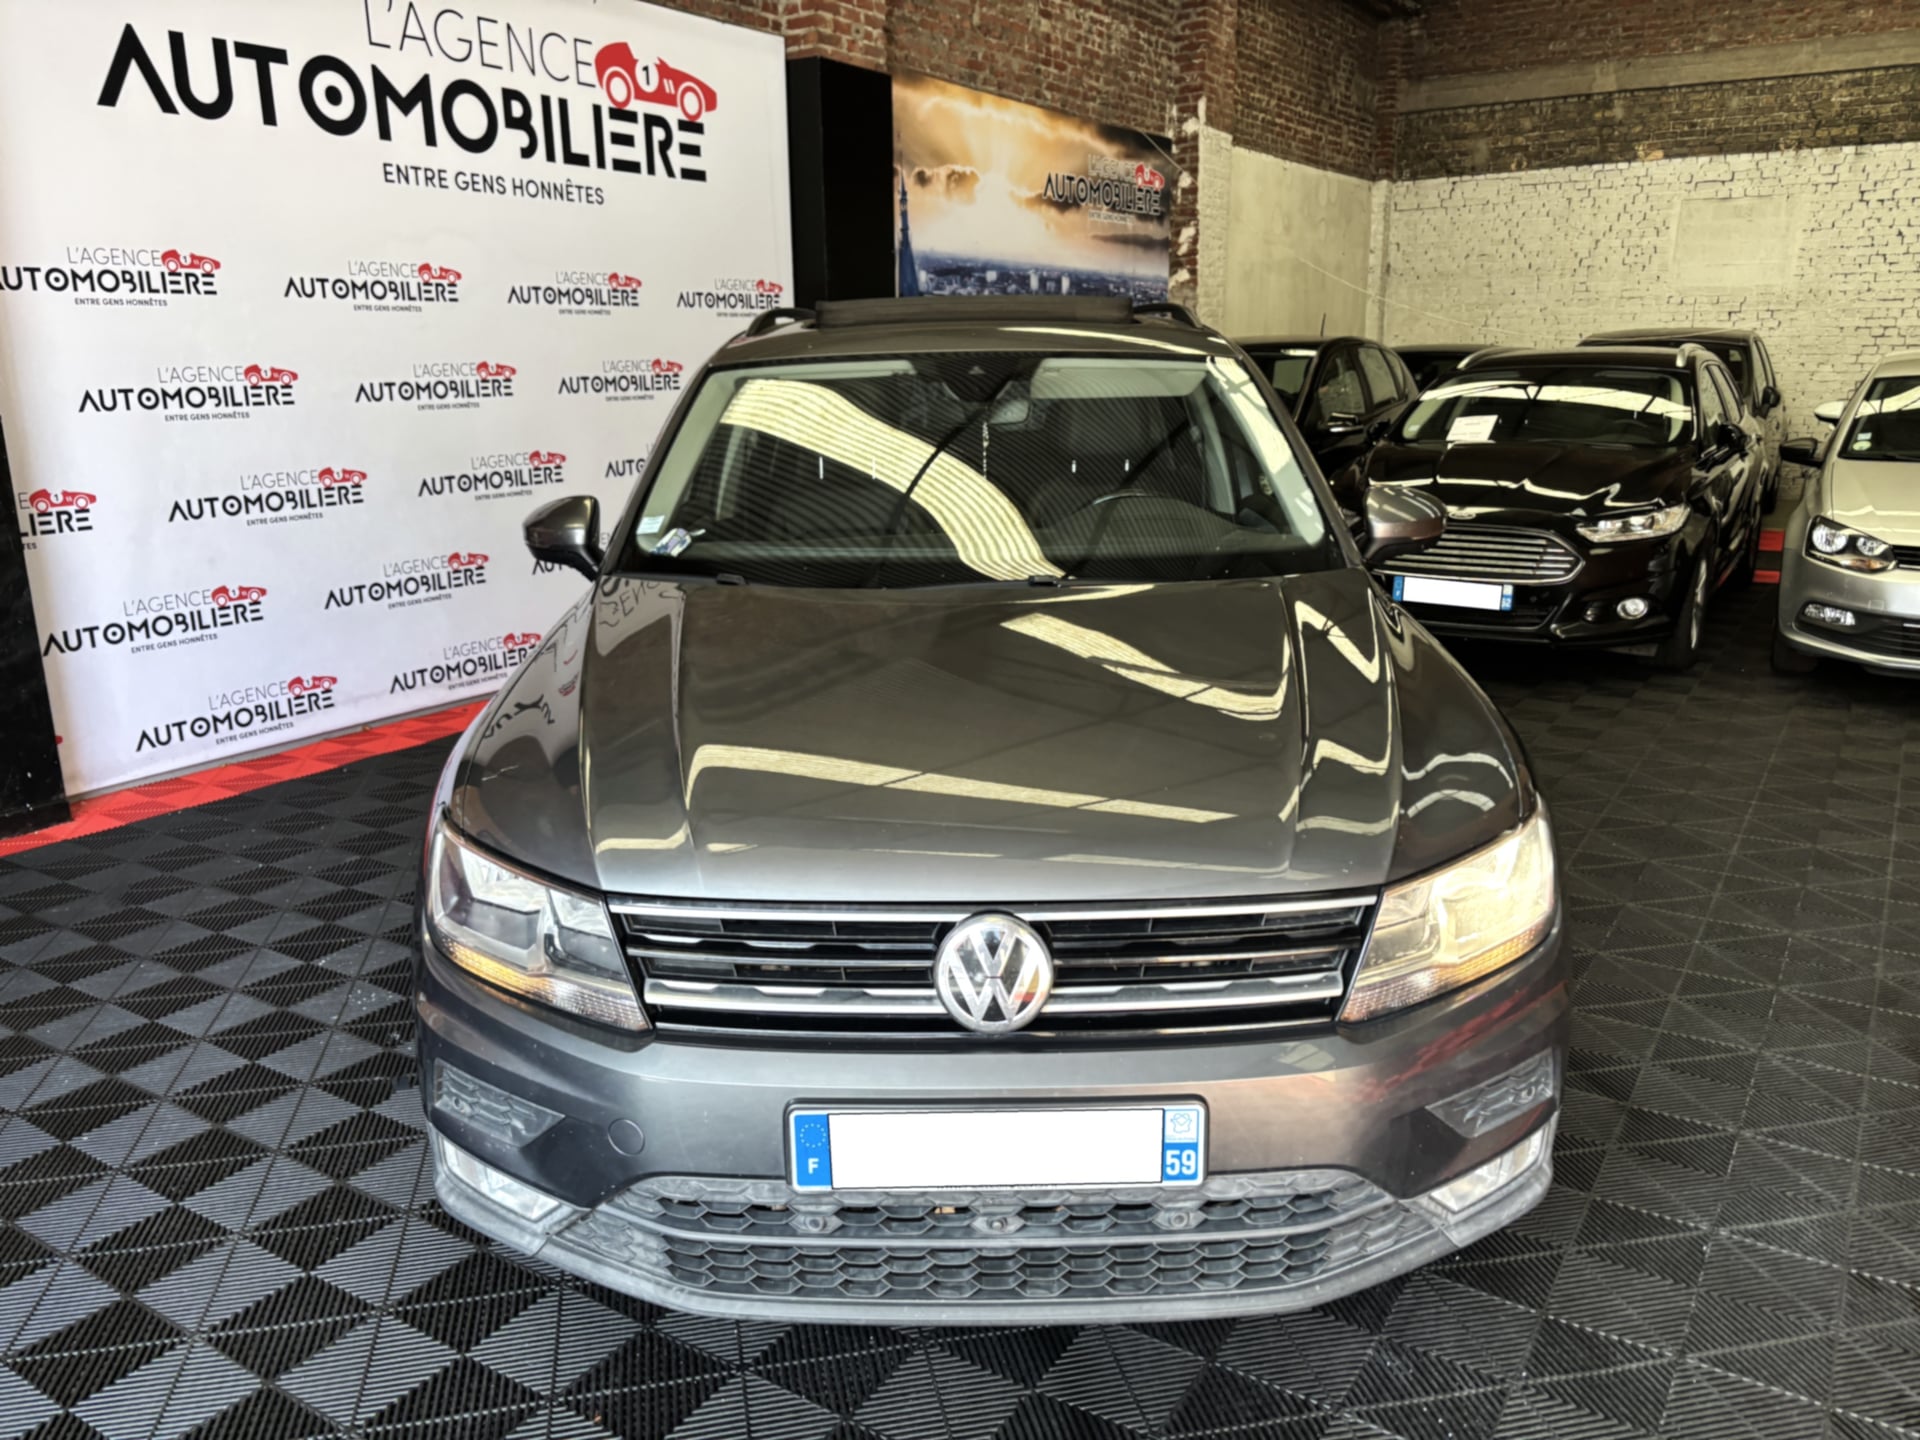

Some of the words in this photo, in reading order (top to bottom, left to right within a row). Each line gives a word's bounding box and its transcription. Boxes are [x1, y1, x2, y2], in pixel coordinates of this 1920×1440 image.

[365, 0, 596, 88] L'AGENCE
[97, 23, 707, 182] AUTOMOBILIERE
[383, 163, 449, 189] ENTRE
[454, 171, 507, 195] GENS
[512, 178, 605, 205] HONNÊTES
[67, 247, 162, 267] L'AGENCE
[348, 261, 418, 278] L'AGENCE
[0, 266, 217, 295] UTOMOBILIERE
[284, 277, 459, 302] AUTOMOBILIERE
[555, 271, 608, 286] L'AGENCE
[507, 285, 639, 307] AUTOMOBILIERE
[157, 366, 245, 384] L'AGENCE
[413, 362, 476, 378] L'AGENCE
[355, 378, 513, 403] AUTOMOBILIERE
[558, 373, 680, 395] AUTOMOBILIERE
[79, 385, 295, 413] AUTOMOBILIERE
[164, 414, 188, 422] ENTRE
[471, 452, 529, 470] L'AGENCE
[241, 469, 319, 491] L'AGENCE
[418, 465, 564, 497] AUTOMOBILIERE
[168, 485, 364, 522] AUTOMOBILIERE
[383, 555, 448, 578] L'AGENCE
[324, 566, 486, 610] AUTOMOBILIERE
[123, 589, 212, 617] L'AGENCE
[42, 601, 264, 657] AUTOMOBILIERE
[131, 644, 155, 654] ENTRE
[157, 640, 177, 649] GENS
[443, 636, 503, 660] L'AGENCE
[208, 680, 288, 711] L'AGENCE
[136, 689, 335, 752] AUTOMOBILIERE
[808, 1158, 819, 1174] F
[1165, 1149, 1196, 1175] 59
